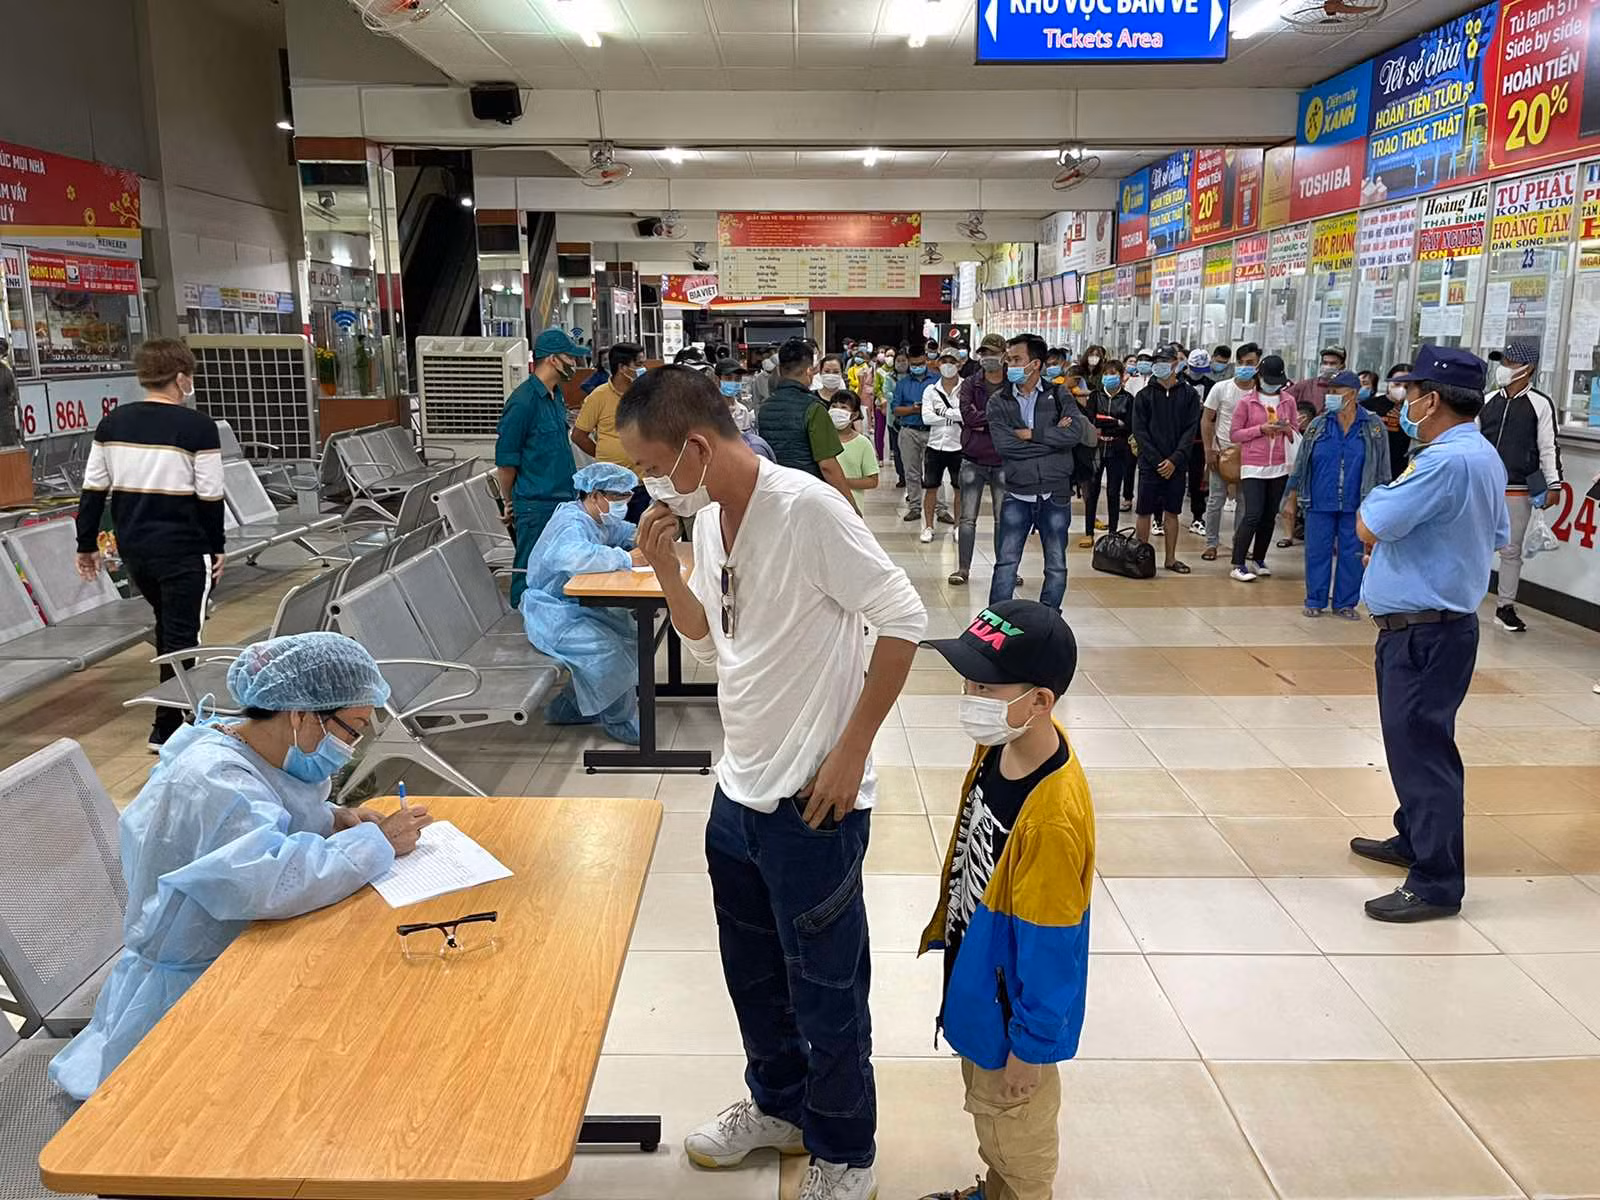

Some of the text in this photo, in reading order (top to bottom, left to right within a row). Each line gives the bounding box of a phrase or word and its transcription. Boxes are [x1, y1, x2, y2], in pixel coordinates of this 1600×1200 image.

[1510, 11, 1525, 36] Tủ
[1526, 1, 1554, 31] lạnh
[1043, 28, 1164, 48] Tickets Area
[1505, 16, 1582, 60] Side by side
[1425, 37, 1461, 78] chia
[1502, 63, 1543, 96] HOÀN
[1322, 103, 1357, 135] XANH
[1375, 101, 1405, 130] HOÀN
[1505, 81, 1569, 151] 20%
[1371, 134, 1399, 159] TRAO
[1401, 123, 1430, 150] THÓC
[12, 155, 28, 174] MỌI
[1299, 165, 1351, 199] TOSHIBA
[1496, 203, 1529, 216] KON
[1536, 196, 1573, 211] TUM
[1420, 246, 1483, 260] KON TUM
[1522, 247, 1535, 269] 23
[22, 404, 36, 434] 6
[56, 400, 89, 430] 86A
[1551, 482, 1597, 549] 24
